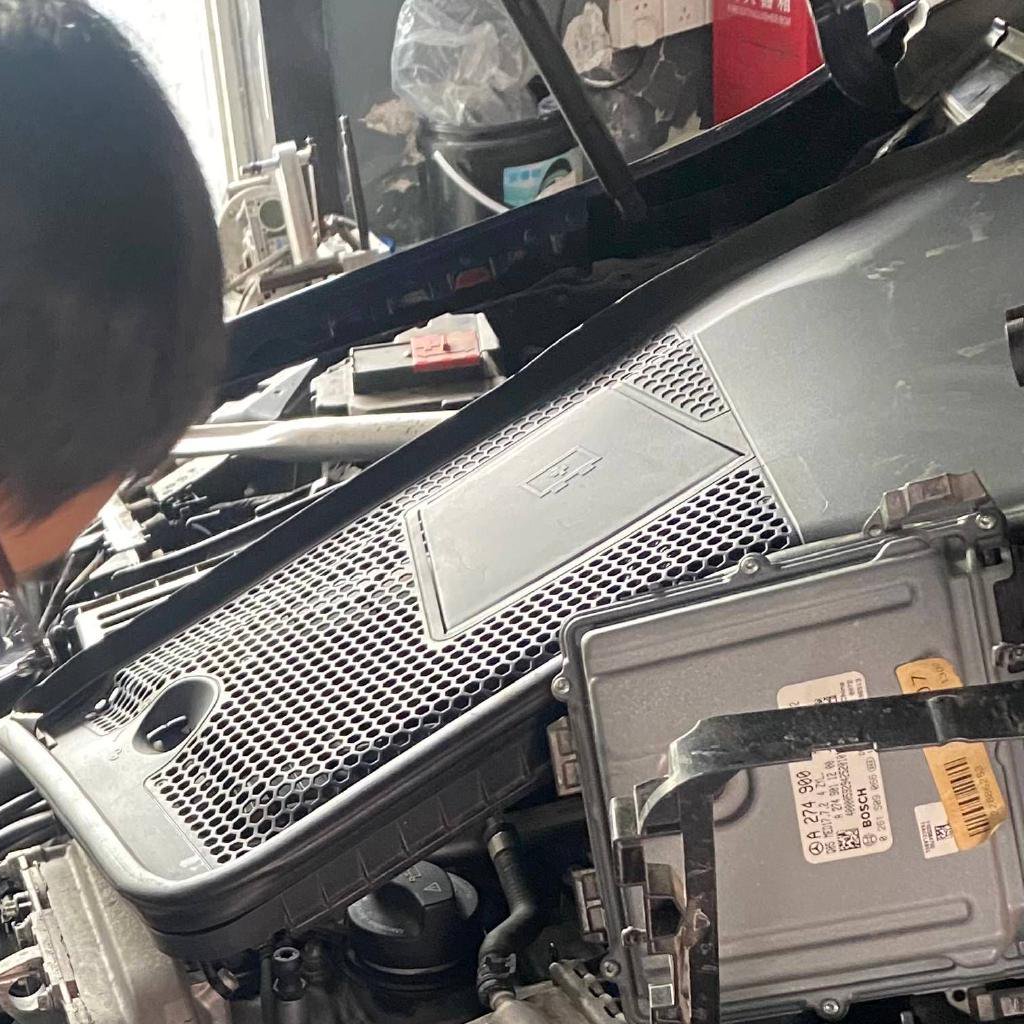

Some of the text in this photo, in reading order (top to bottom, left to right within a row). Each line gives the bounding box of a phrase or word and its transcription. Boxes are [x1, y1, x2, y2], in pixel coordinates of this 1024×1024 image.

[796, 770, 814, 794] 900
[800, 801, 820, 825] 274
[857, 787, 872, 828] BOSCH
[807, 830, 822, 840] A
